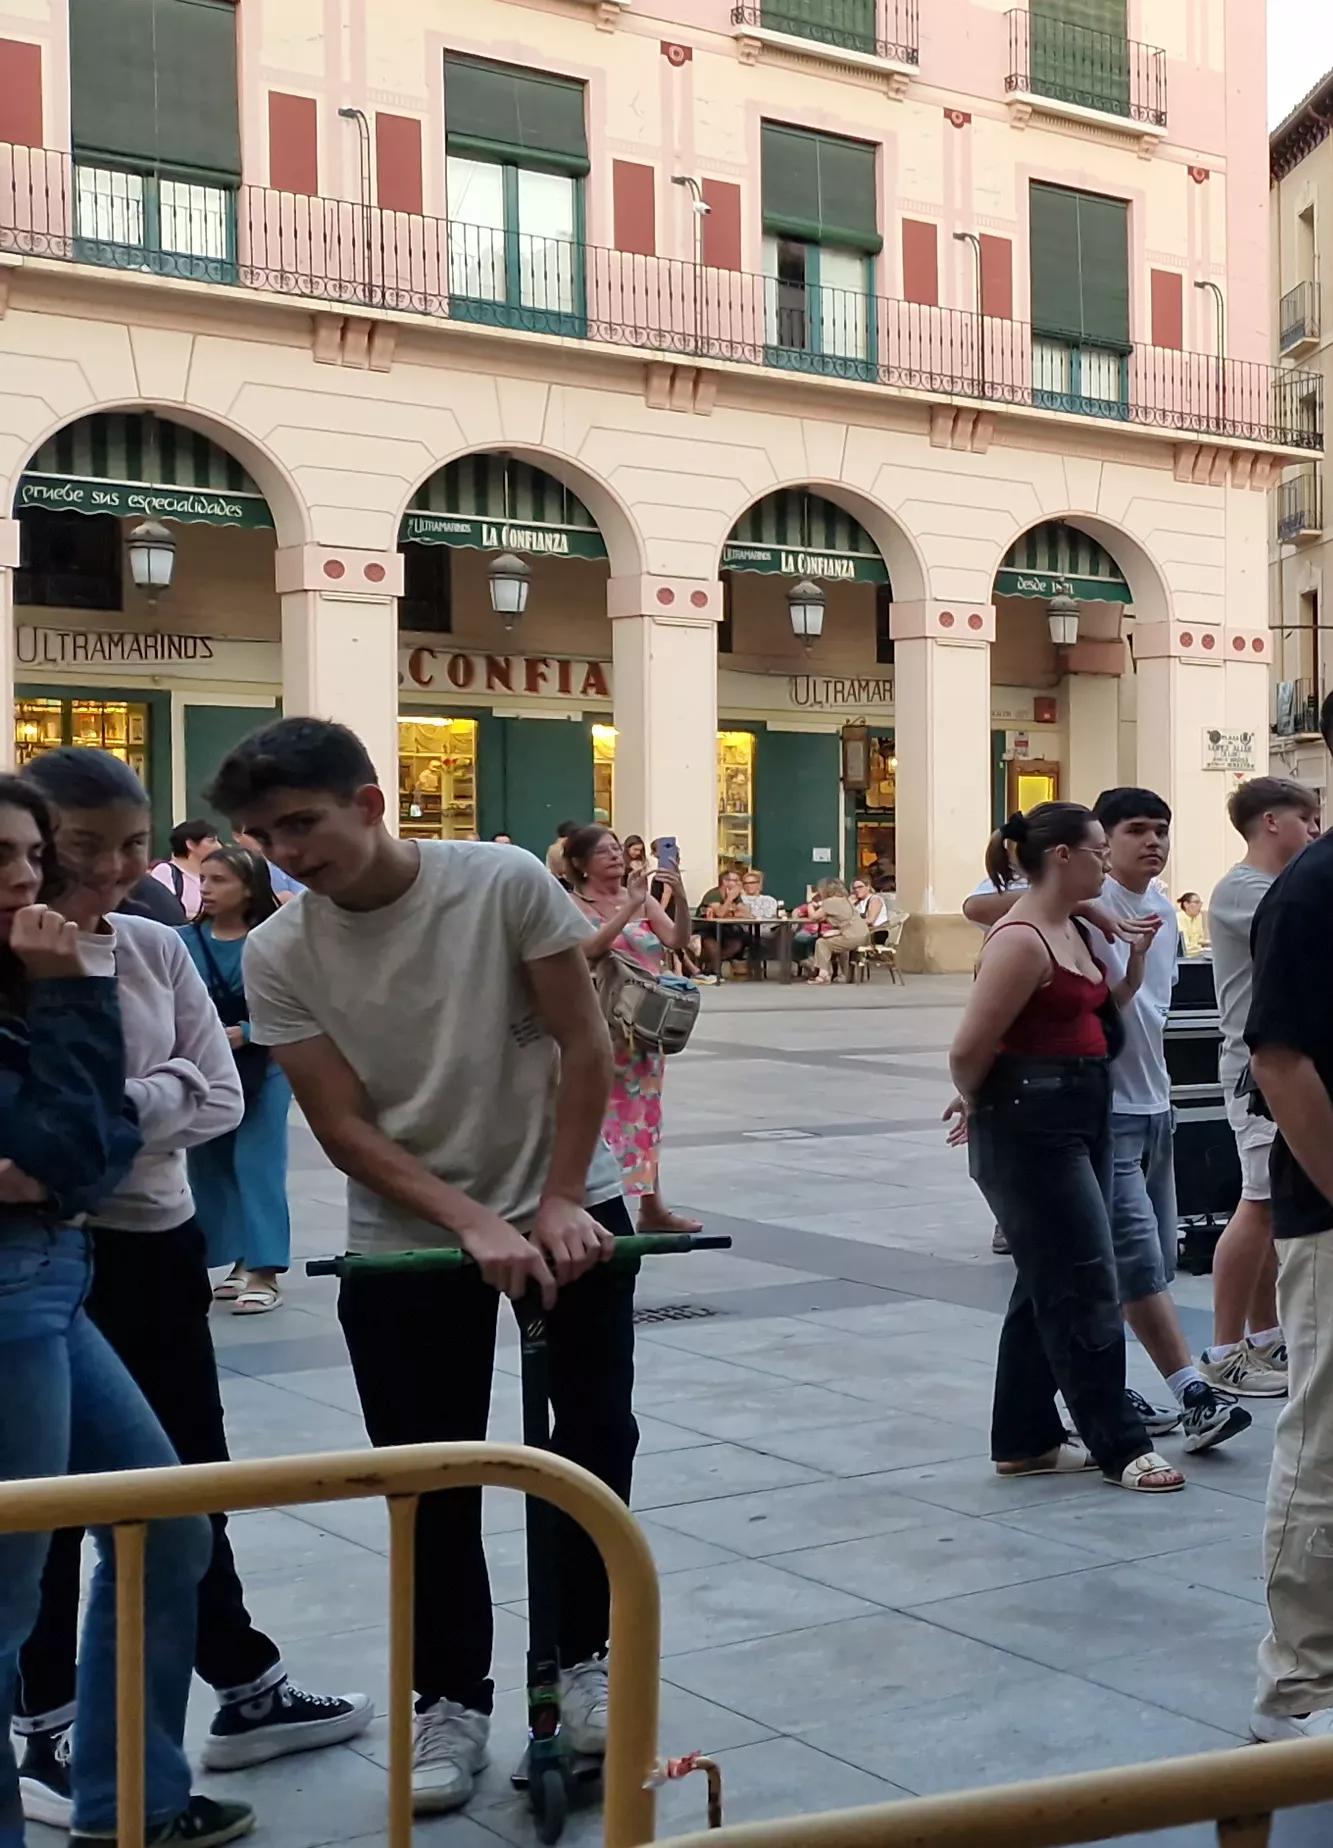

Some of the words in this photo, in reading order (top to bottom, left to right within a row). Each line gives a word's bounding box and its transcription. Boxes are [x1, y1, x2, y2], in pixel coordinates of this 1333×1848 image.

[22, 484, 84, 503] pruebe
[91, 491, 119, 506] sus
[128, 494, 243, 518] especialidades
[413, 517, 472, 534] ULTRAMARINOS
[482, 523, 498, 546] LA
[502, 526, 568, 553] CONFIANZA
[781, 552, 794, 573] LA
[1017, 576, 1046, 592] desde
[16, 627, 213, 662] ULTRAMARINOS
[408, 647, 610, 696] CONFIA
[794, 676, 893, 706] ULTRAMAR
